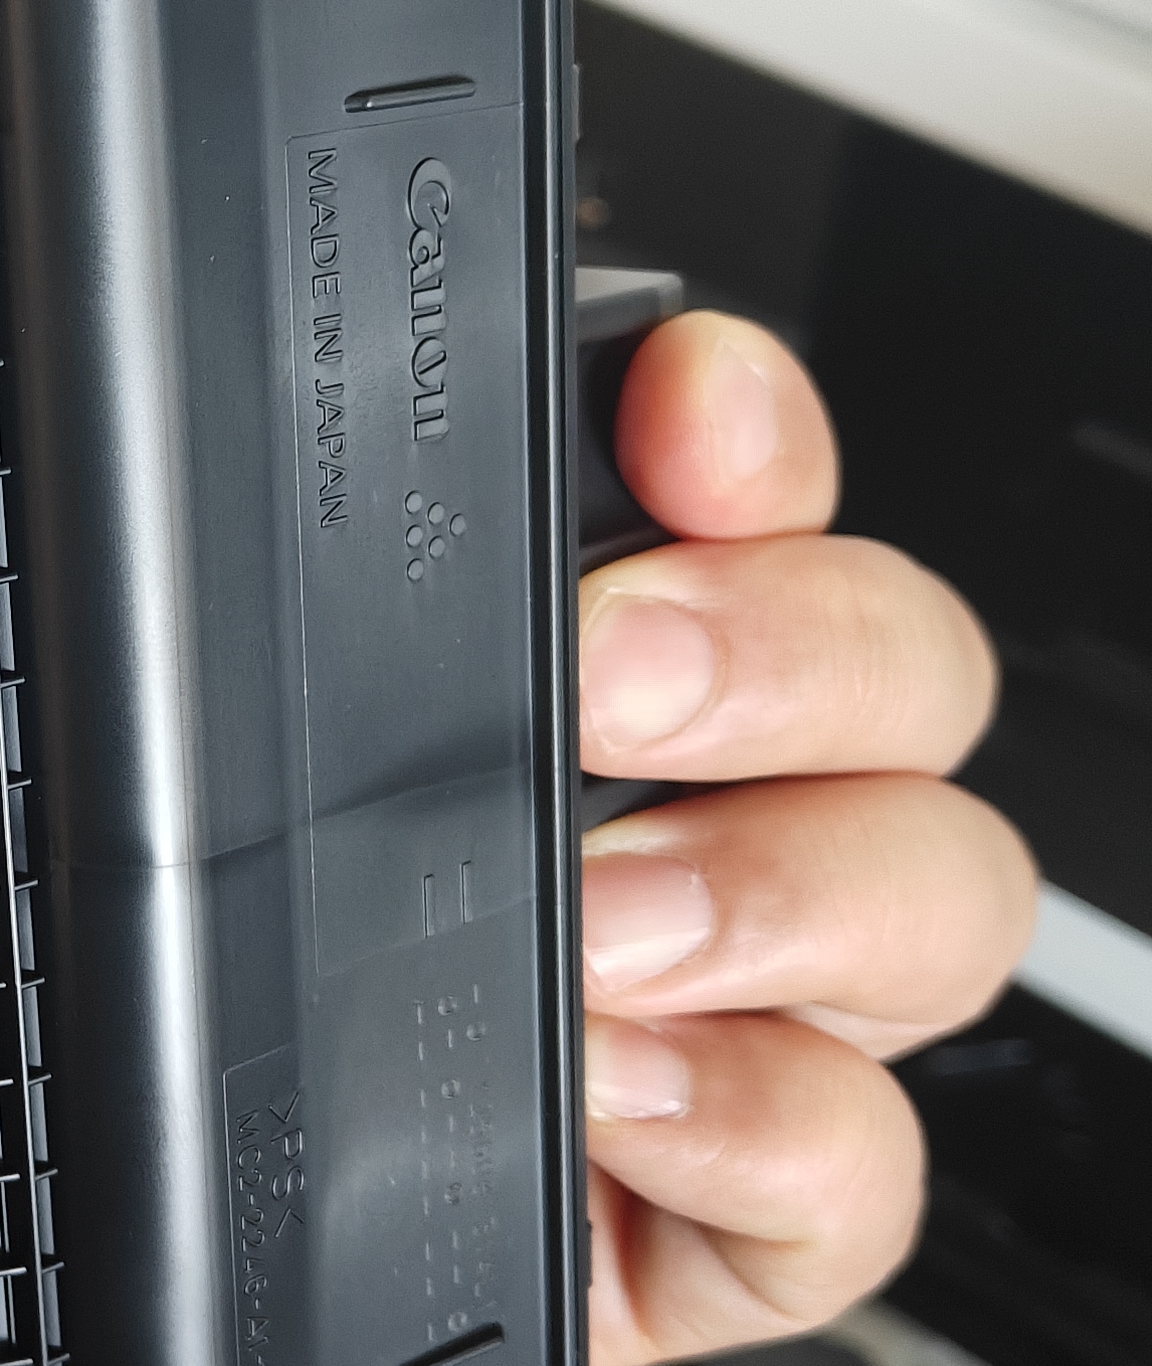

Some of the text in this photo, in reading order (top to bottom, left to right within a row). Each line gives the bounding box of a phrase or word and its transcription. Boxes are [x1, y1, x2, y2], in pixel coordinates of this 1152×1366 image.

[306, 147, 351, 531] MADE IN JAPAN
[405, 156, 451, 443] Canon
